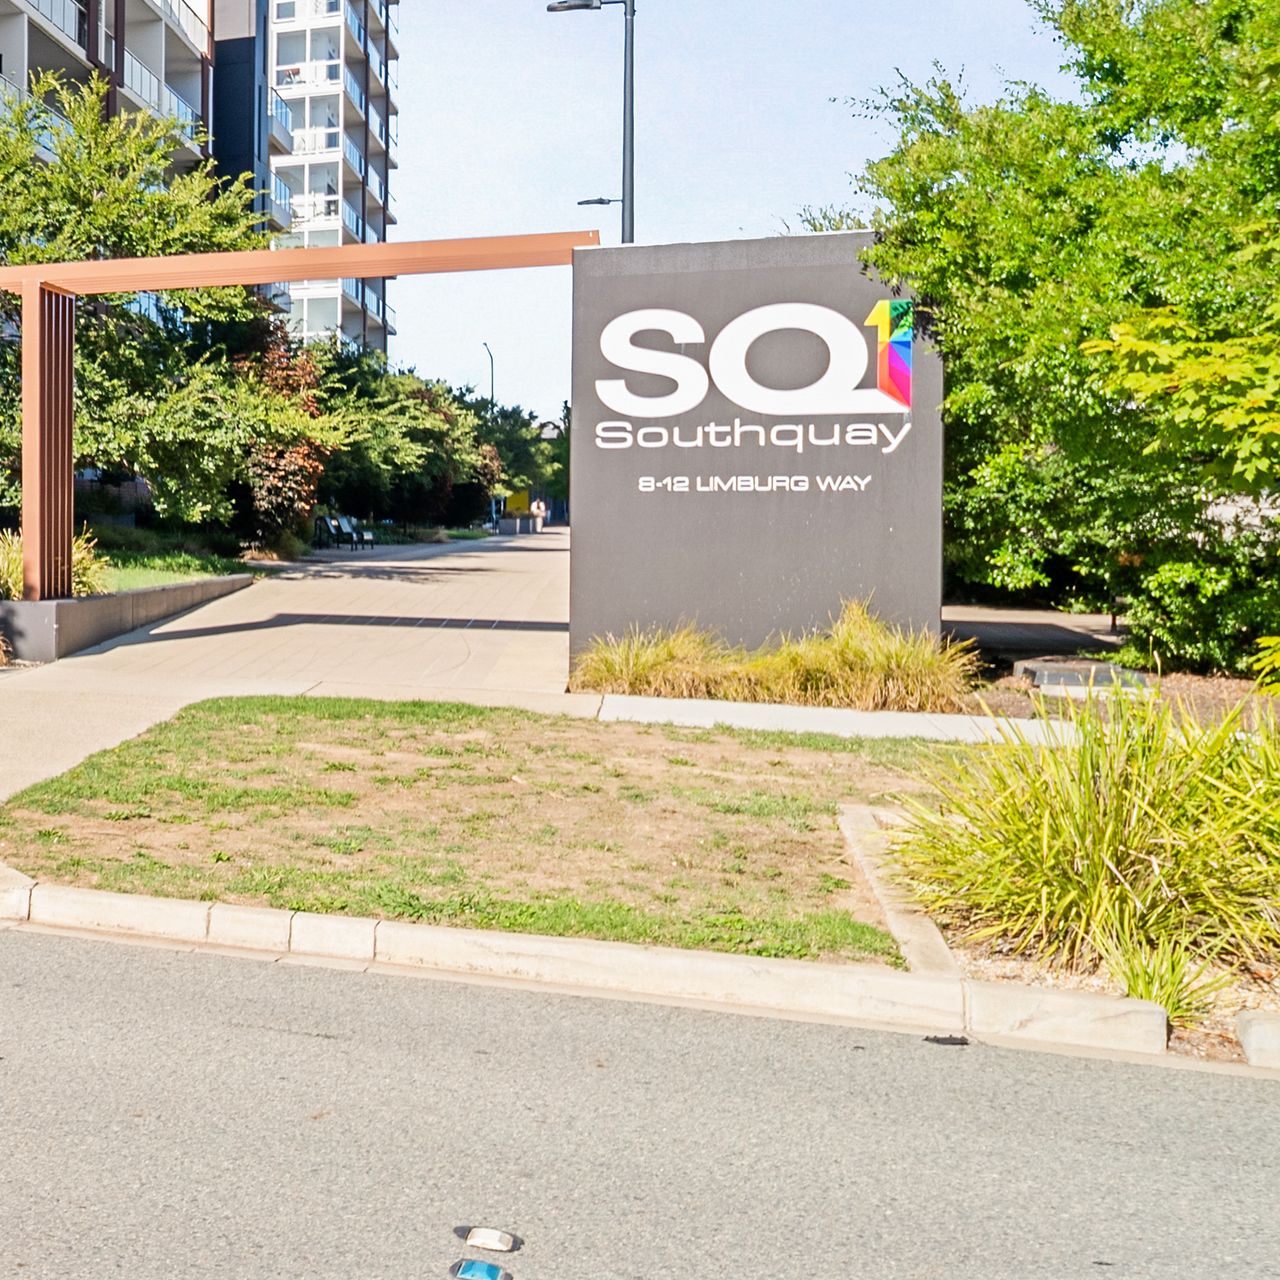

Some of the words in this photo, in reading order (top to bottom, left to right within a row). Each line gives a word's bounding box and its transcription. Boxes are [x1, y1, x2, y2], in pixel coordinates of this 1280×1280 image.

[594, 418, 912, 453] Southquay
[638, 476, 690, 492] 8-12
[696, 475, 810, 492] LIMBURG
[815, 475, 872, 492] WAY
